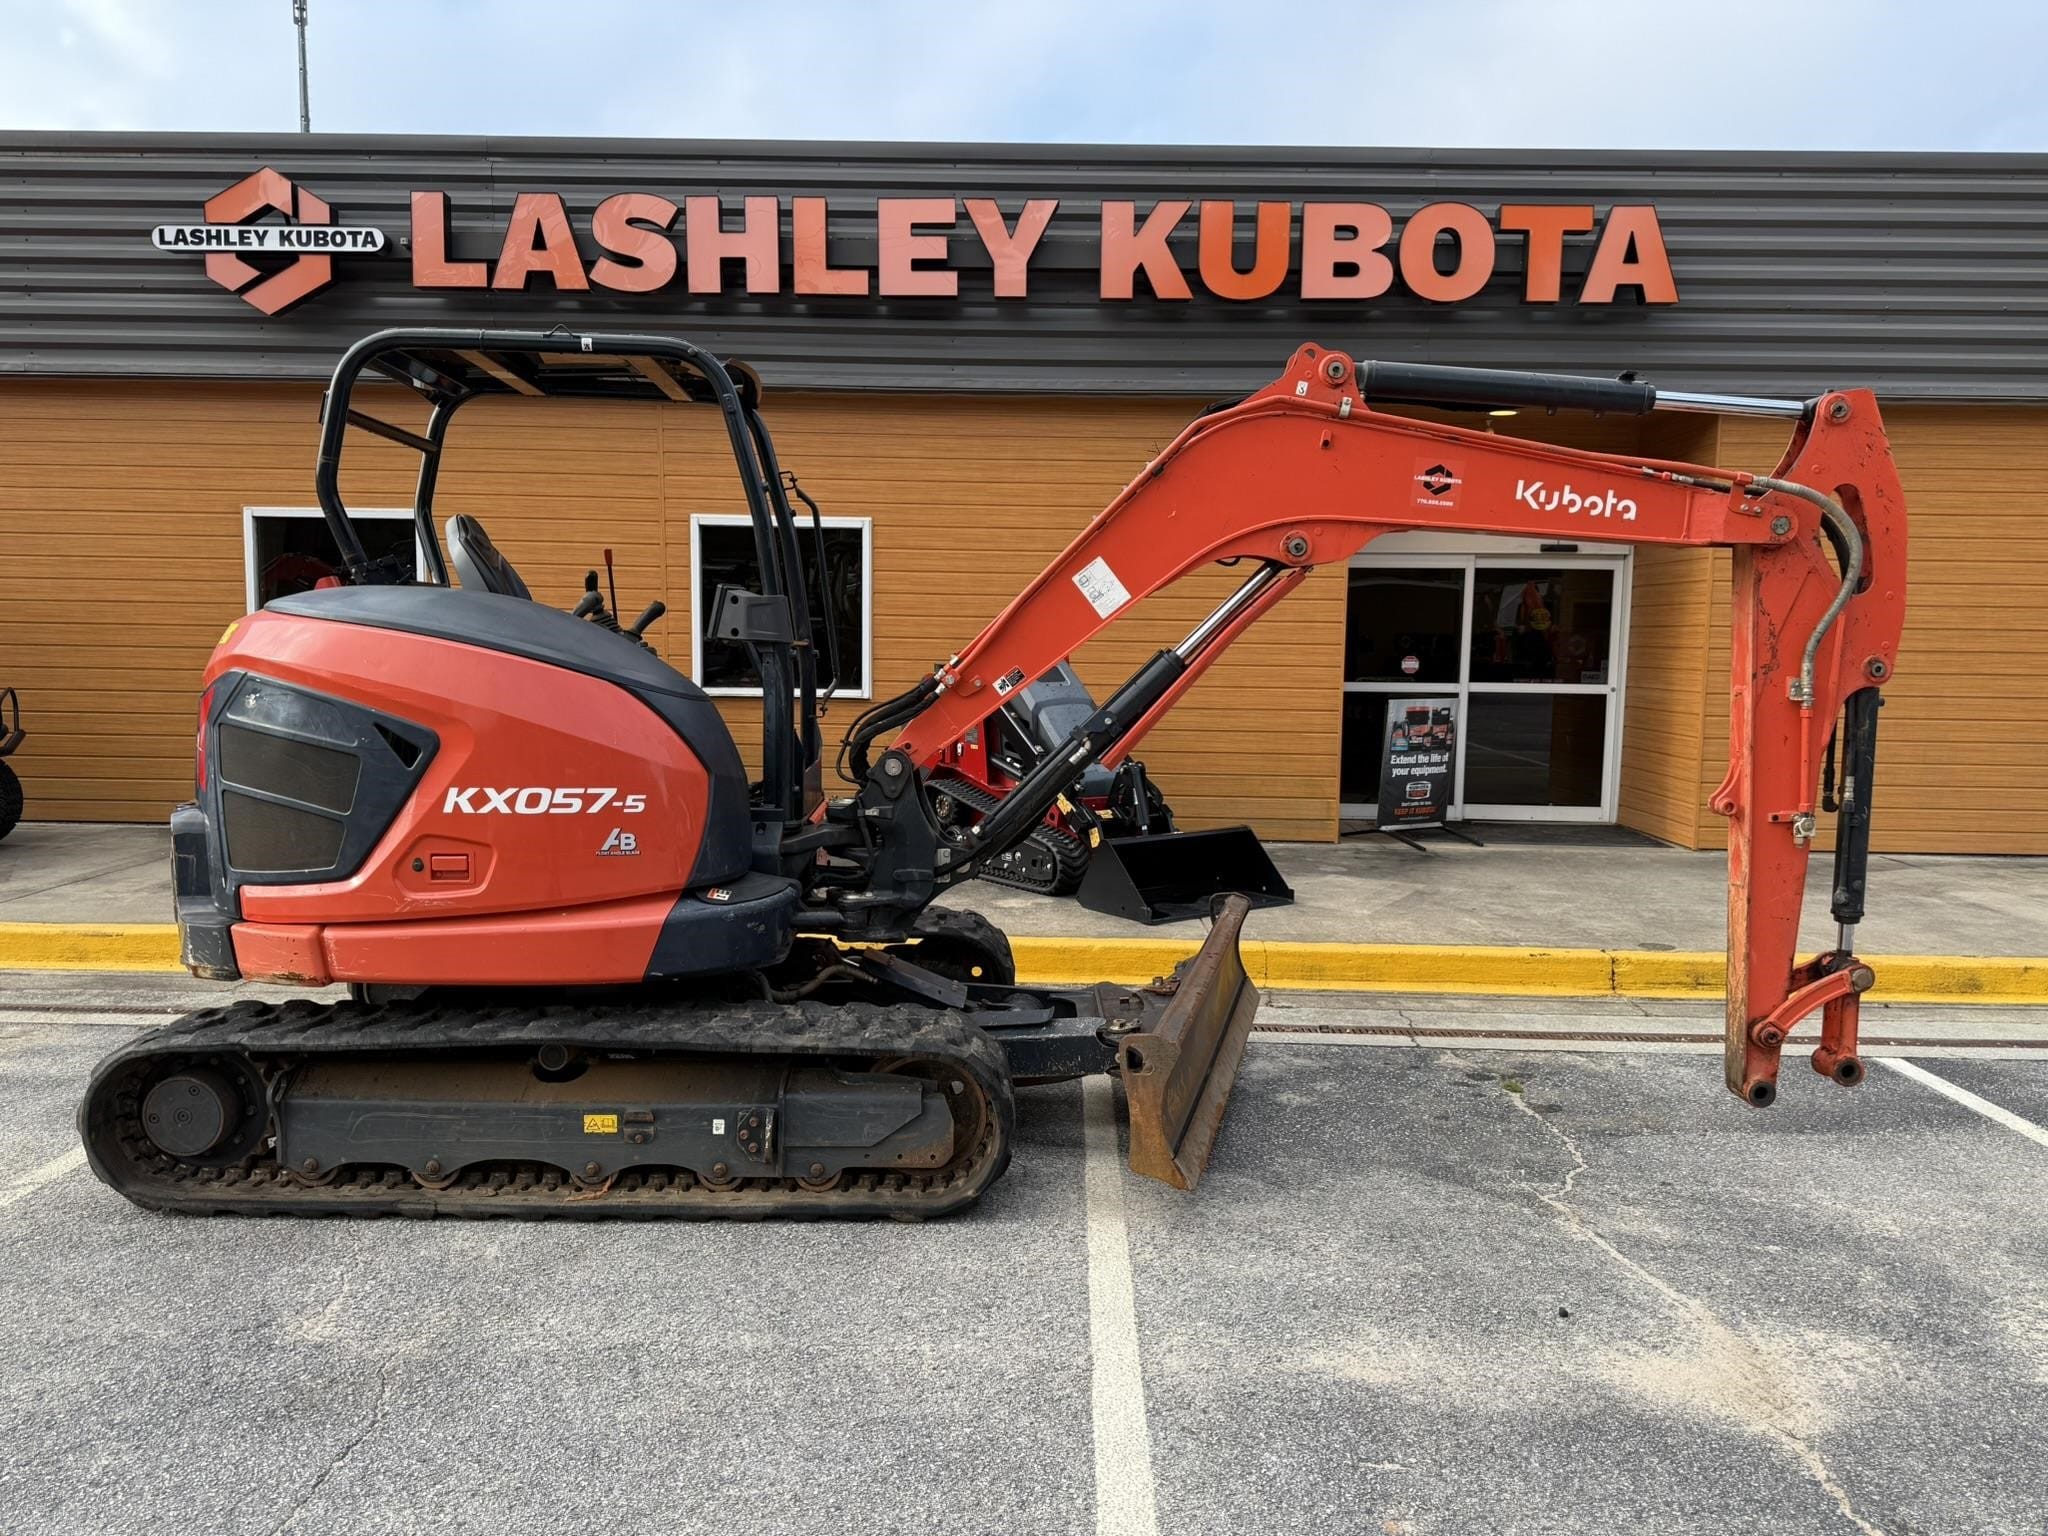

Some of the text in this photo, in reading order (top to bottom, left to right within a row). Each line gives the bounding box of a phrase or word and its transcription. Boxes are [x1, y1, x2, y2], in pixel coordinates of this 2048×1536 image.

[158, 228, 377, 248] LASHLEY KUBOTA
[411, 190, 1679, 304] LASHLEY KUBOTA
[1515, 479, 1637, 520] Kubota
[1391, 751, 1449, 764] Extend the life of
[1391, 764, 1447, 777] your equipment.
[443, 787, 647, 814] KX057-5
